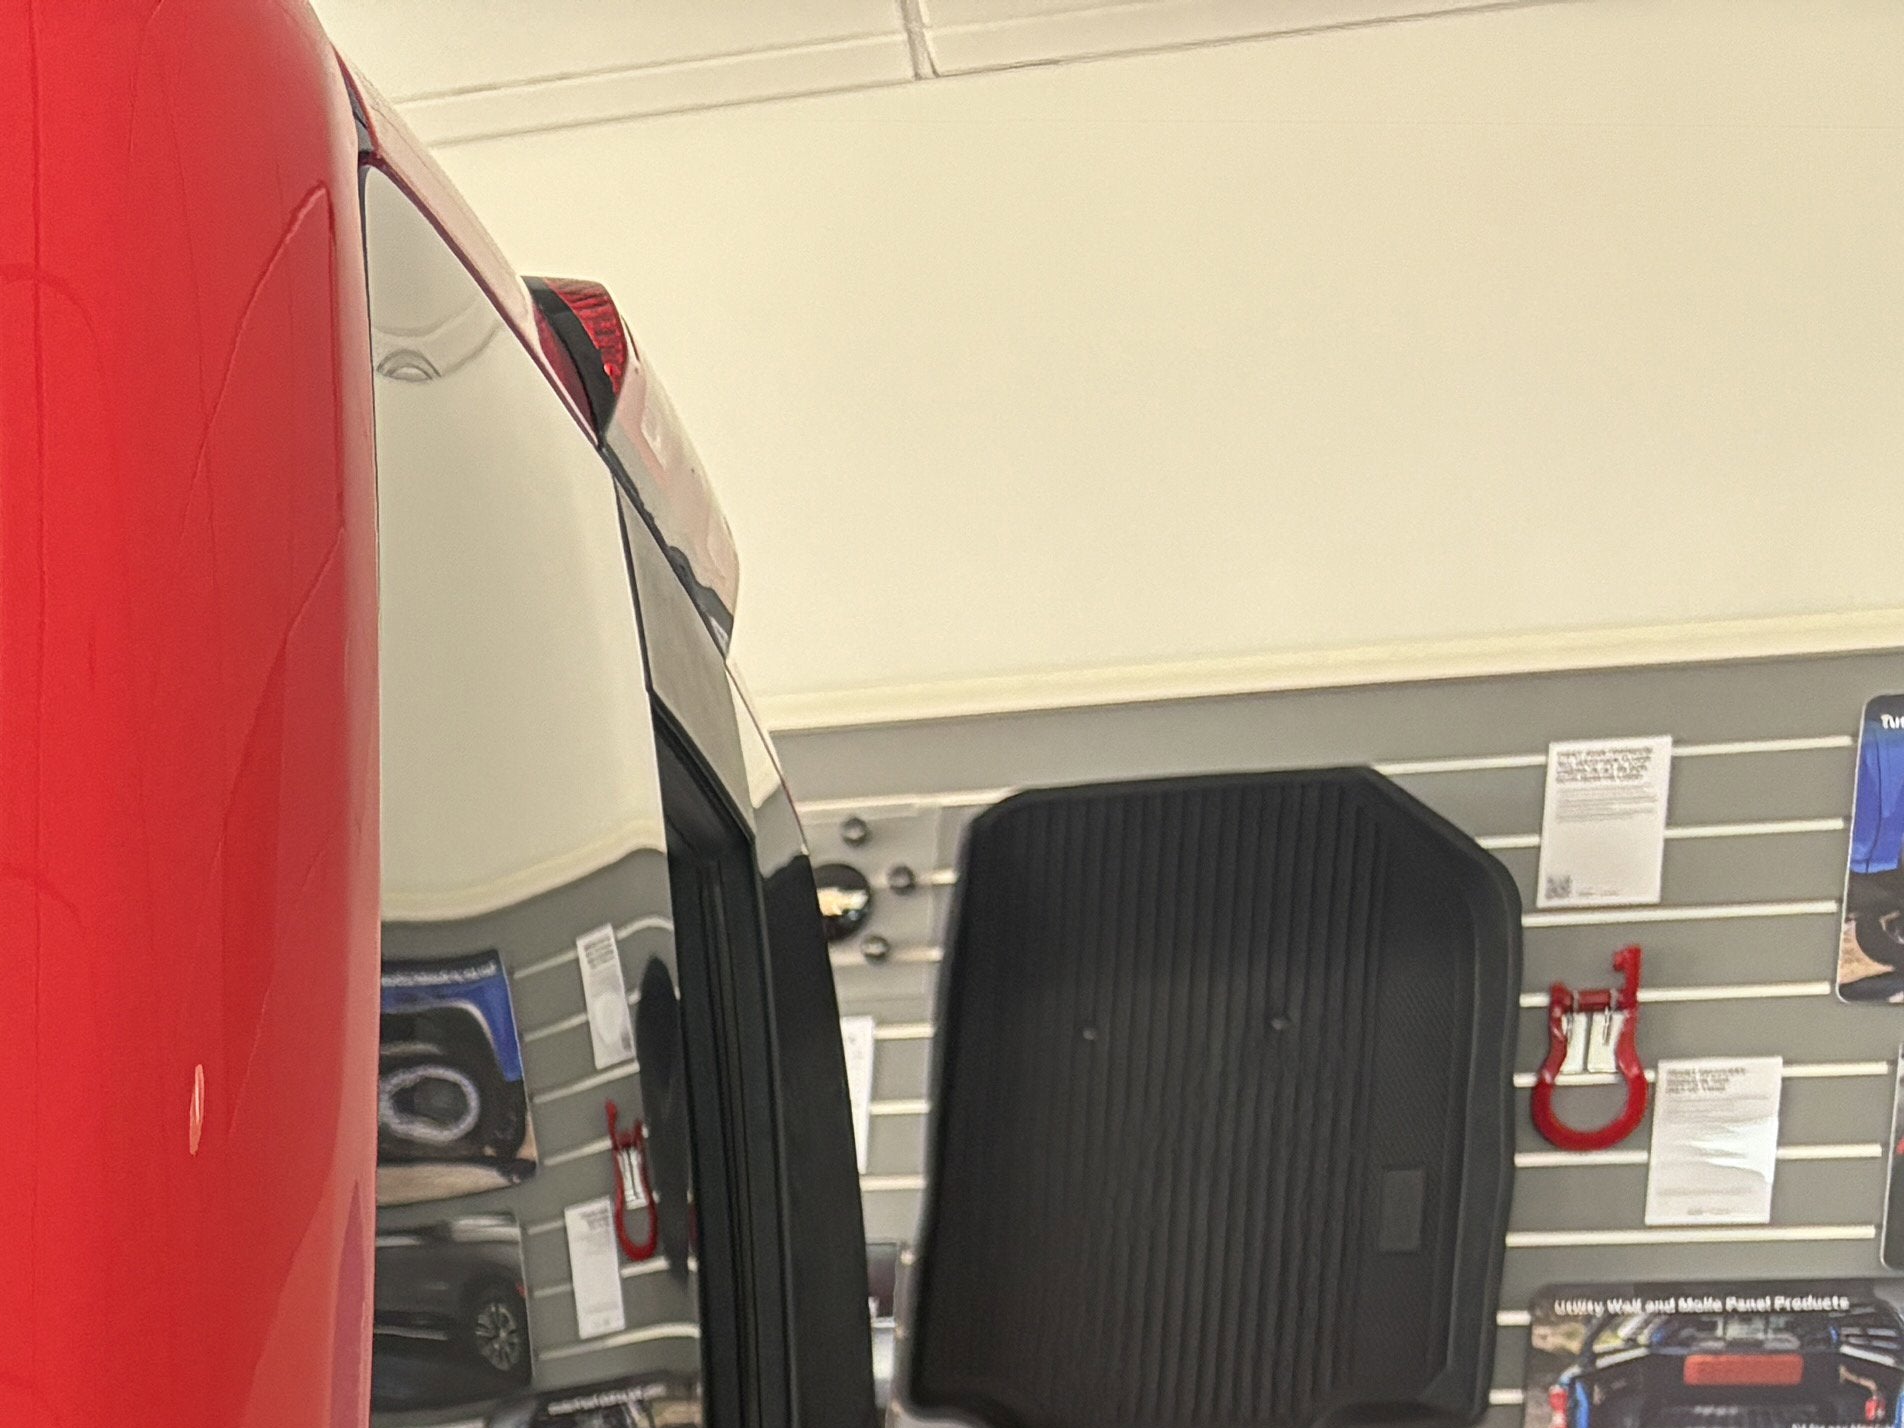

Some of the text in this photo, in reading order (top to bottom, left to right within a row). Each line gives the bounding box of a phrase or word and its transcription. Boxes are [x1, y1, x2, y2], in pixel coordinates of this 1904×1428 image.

[1554, 1299, 1604, 1318] Utility
[1607, 1297, 1642, 1314] Wall
[1645, 1296, 1676, 1313] and
[1725, 1295, 1771, 1312] Panel
[1774, 1294, 1850, 1312] Products
